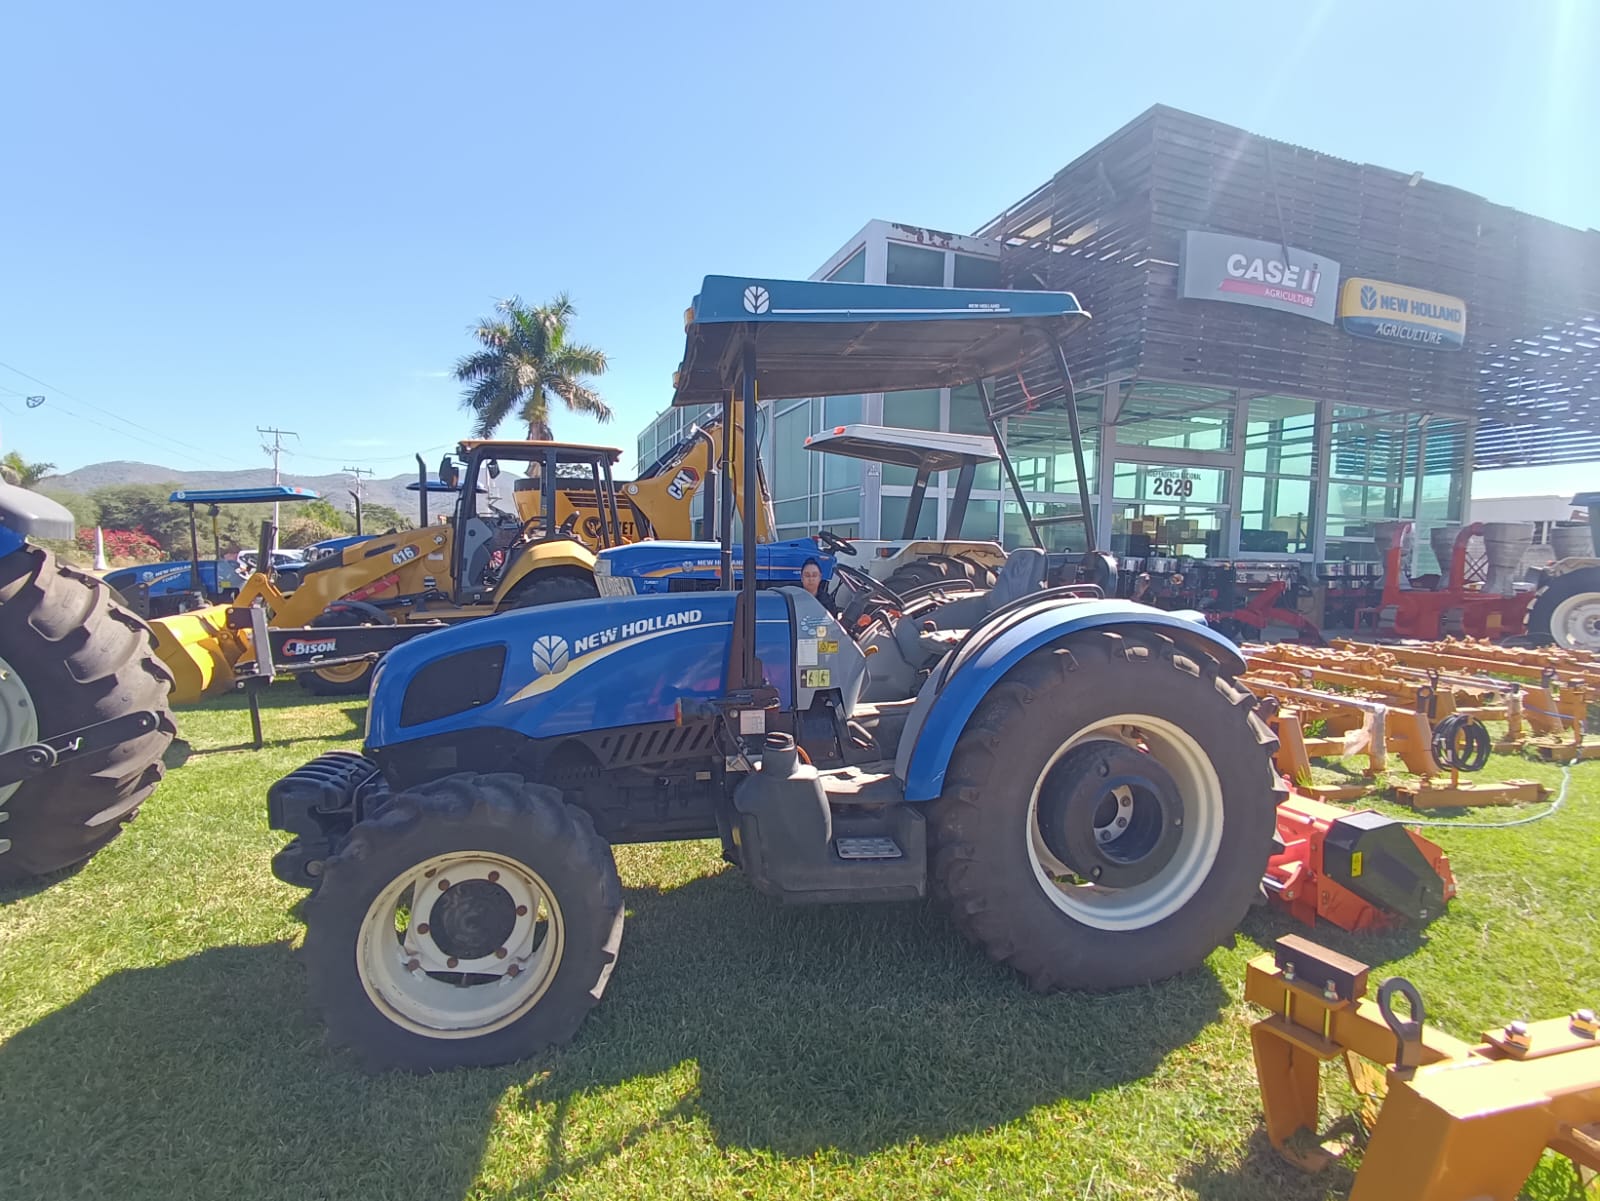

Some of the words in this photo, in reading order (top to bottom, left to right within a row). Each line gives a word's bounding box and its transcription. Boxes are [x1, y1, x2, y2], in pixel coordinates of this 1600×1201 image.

[1226, 253, 1300, 288] CASE
[1263, 288, 1315, 307] AGRICULTURE
[1380, 294, 1409, 313] NEW
[1410, 300, 1462, 323] HOLLAND
[1375, 322, 1443, 344] AGRICULTURE
[667, 468, 693, 500] CAT
[1153, 478, 1193, 497] 2629
[392, 546, 415, 564] 416
[574, 627, 618, 654] NEW
[621, 609, 703, 639] HOLLAND
